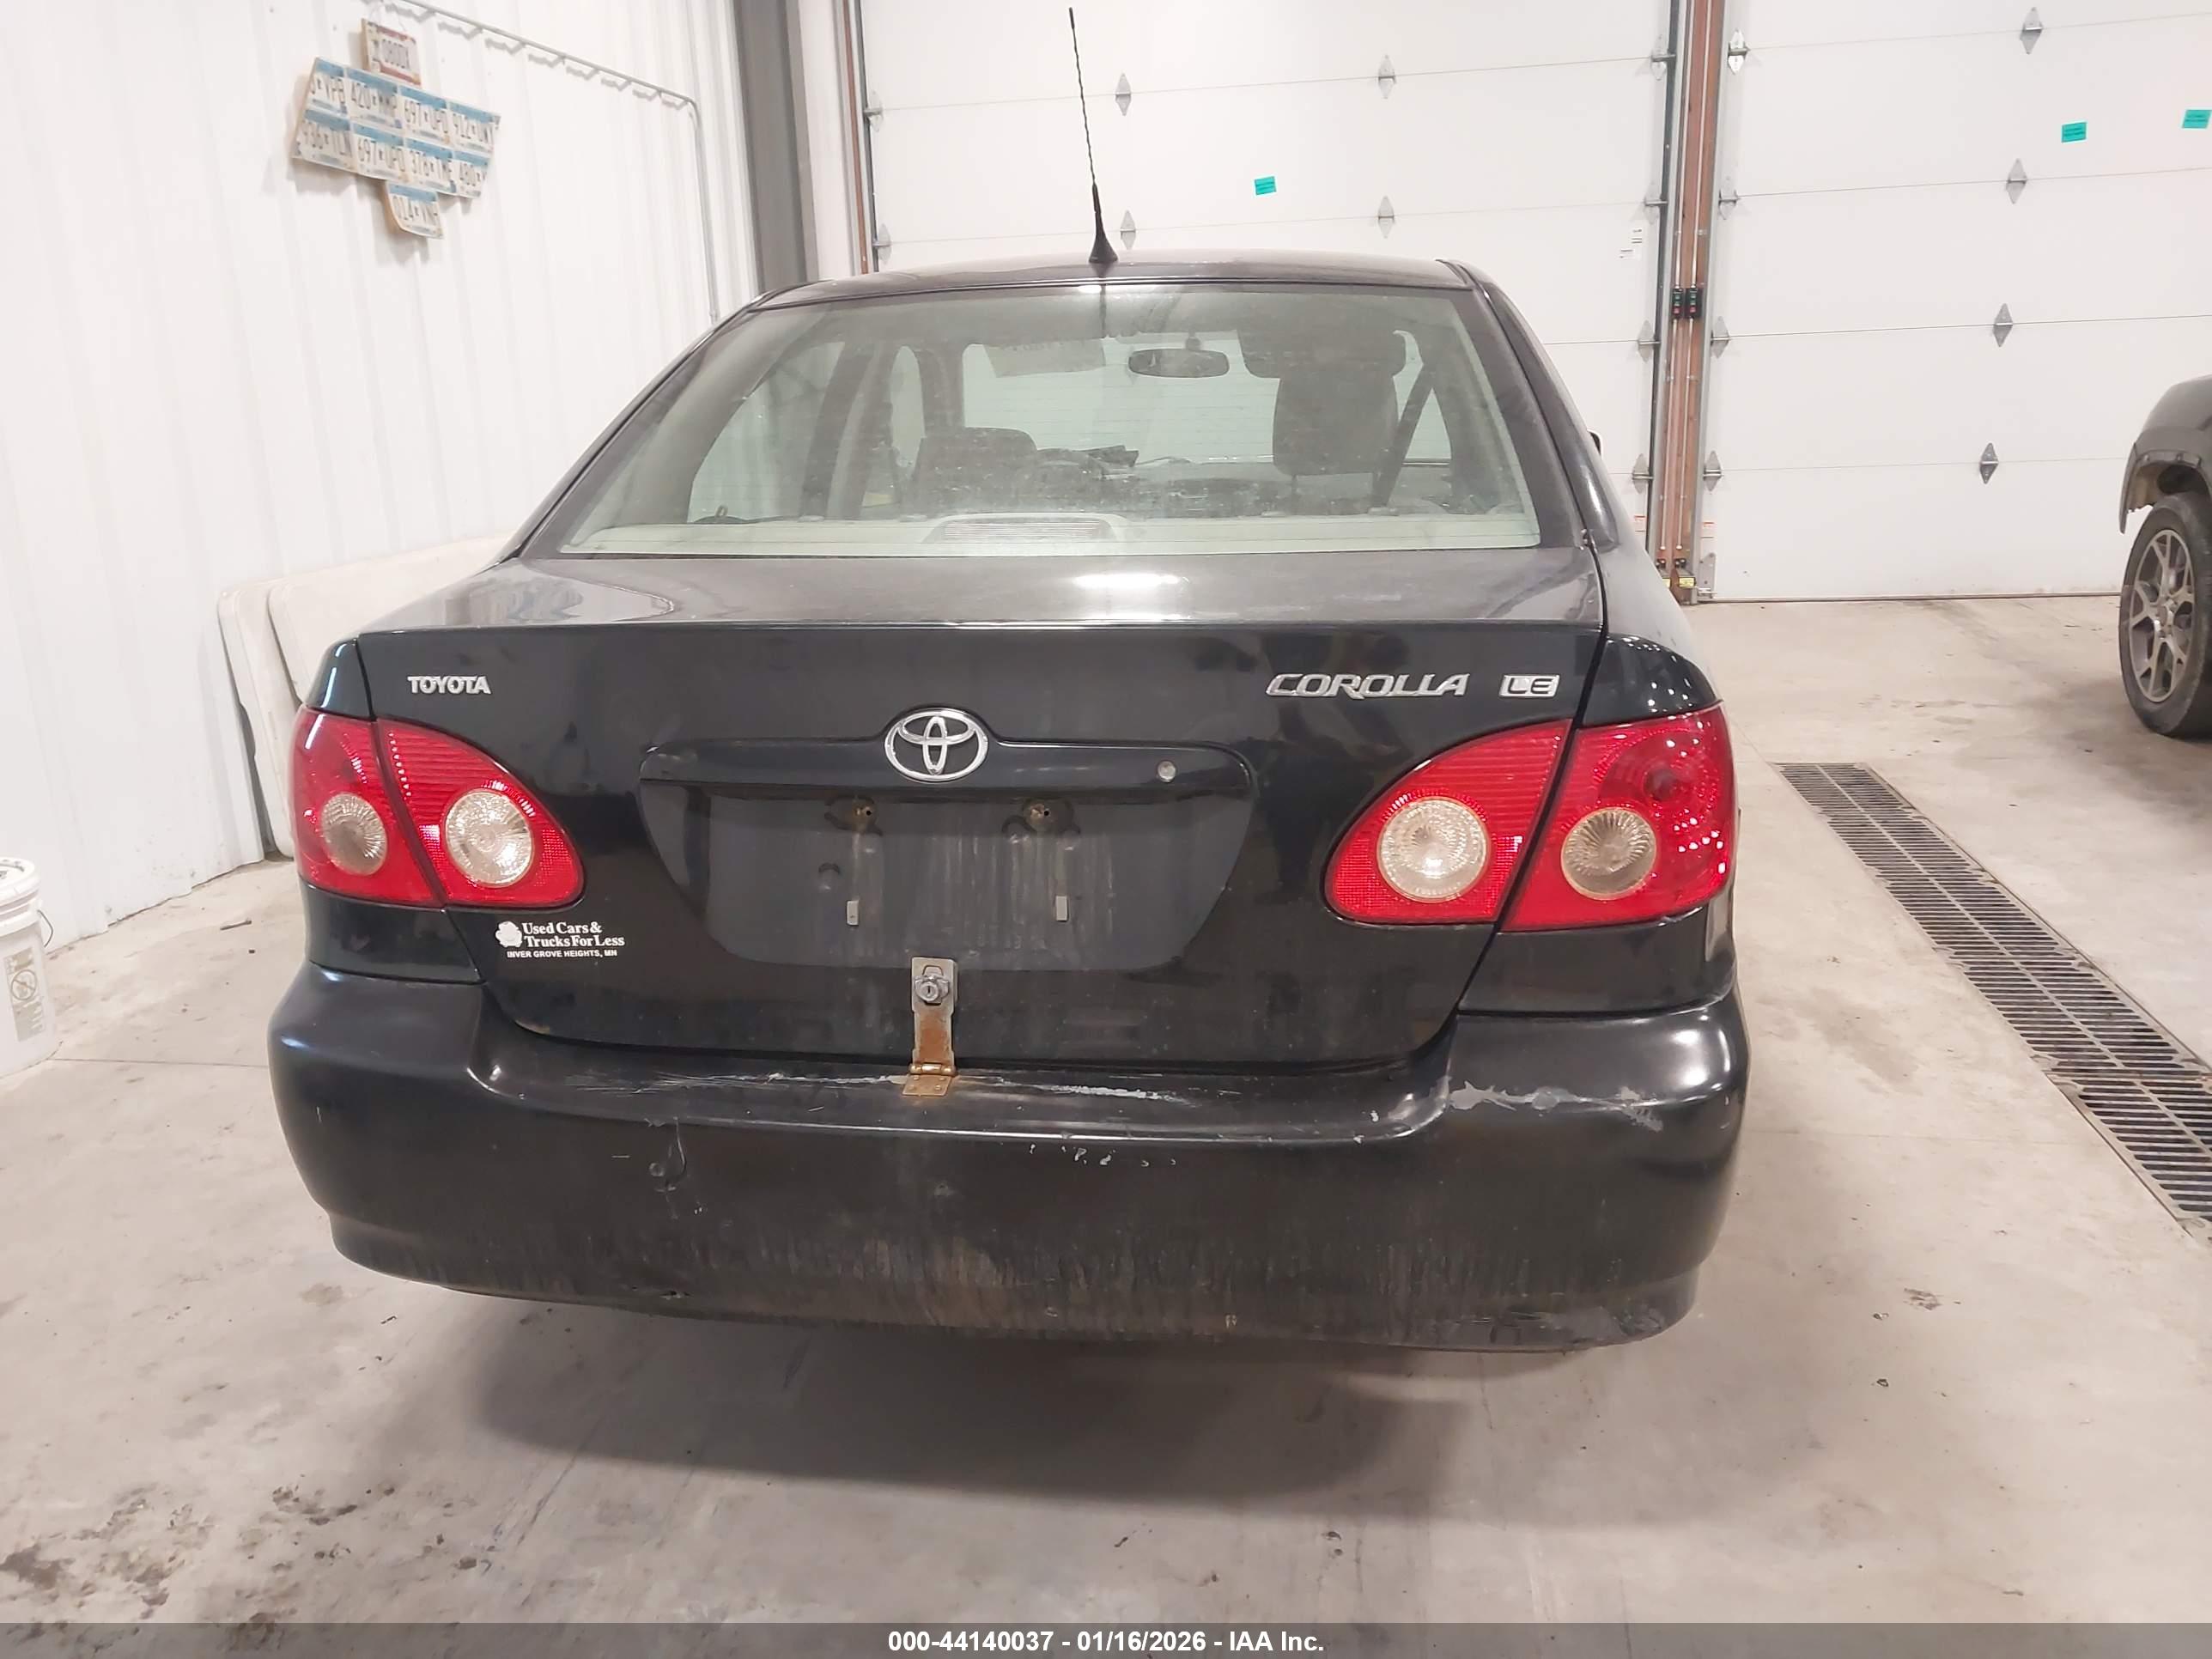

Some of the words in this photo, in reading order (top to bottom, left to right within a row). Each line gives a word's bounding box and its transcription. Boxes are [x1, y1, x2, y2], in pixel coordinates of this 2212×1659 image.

[407, 676, 492, 694] TOYOTA
[1265, 673, 1470, 699] COROLLA
[1503, 676, 1557, 696] LE
[521, 922, 555, 934] Used
[556, 921, 589, 934] Cars
[524, 935, 570, 947] Trucks
[571, 934, 593, 946] For
[594, 934, 625, 946] Less
[533, 950, 562, 958] GROVE
[563, 949, 603, 958] HEIGHTS,
